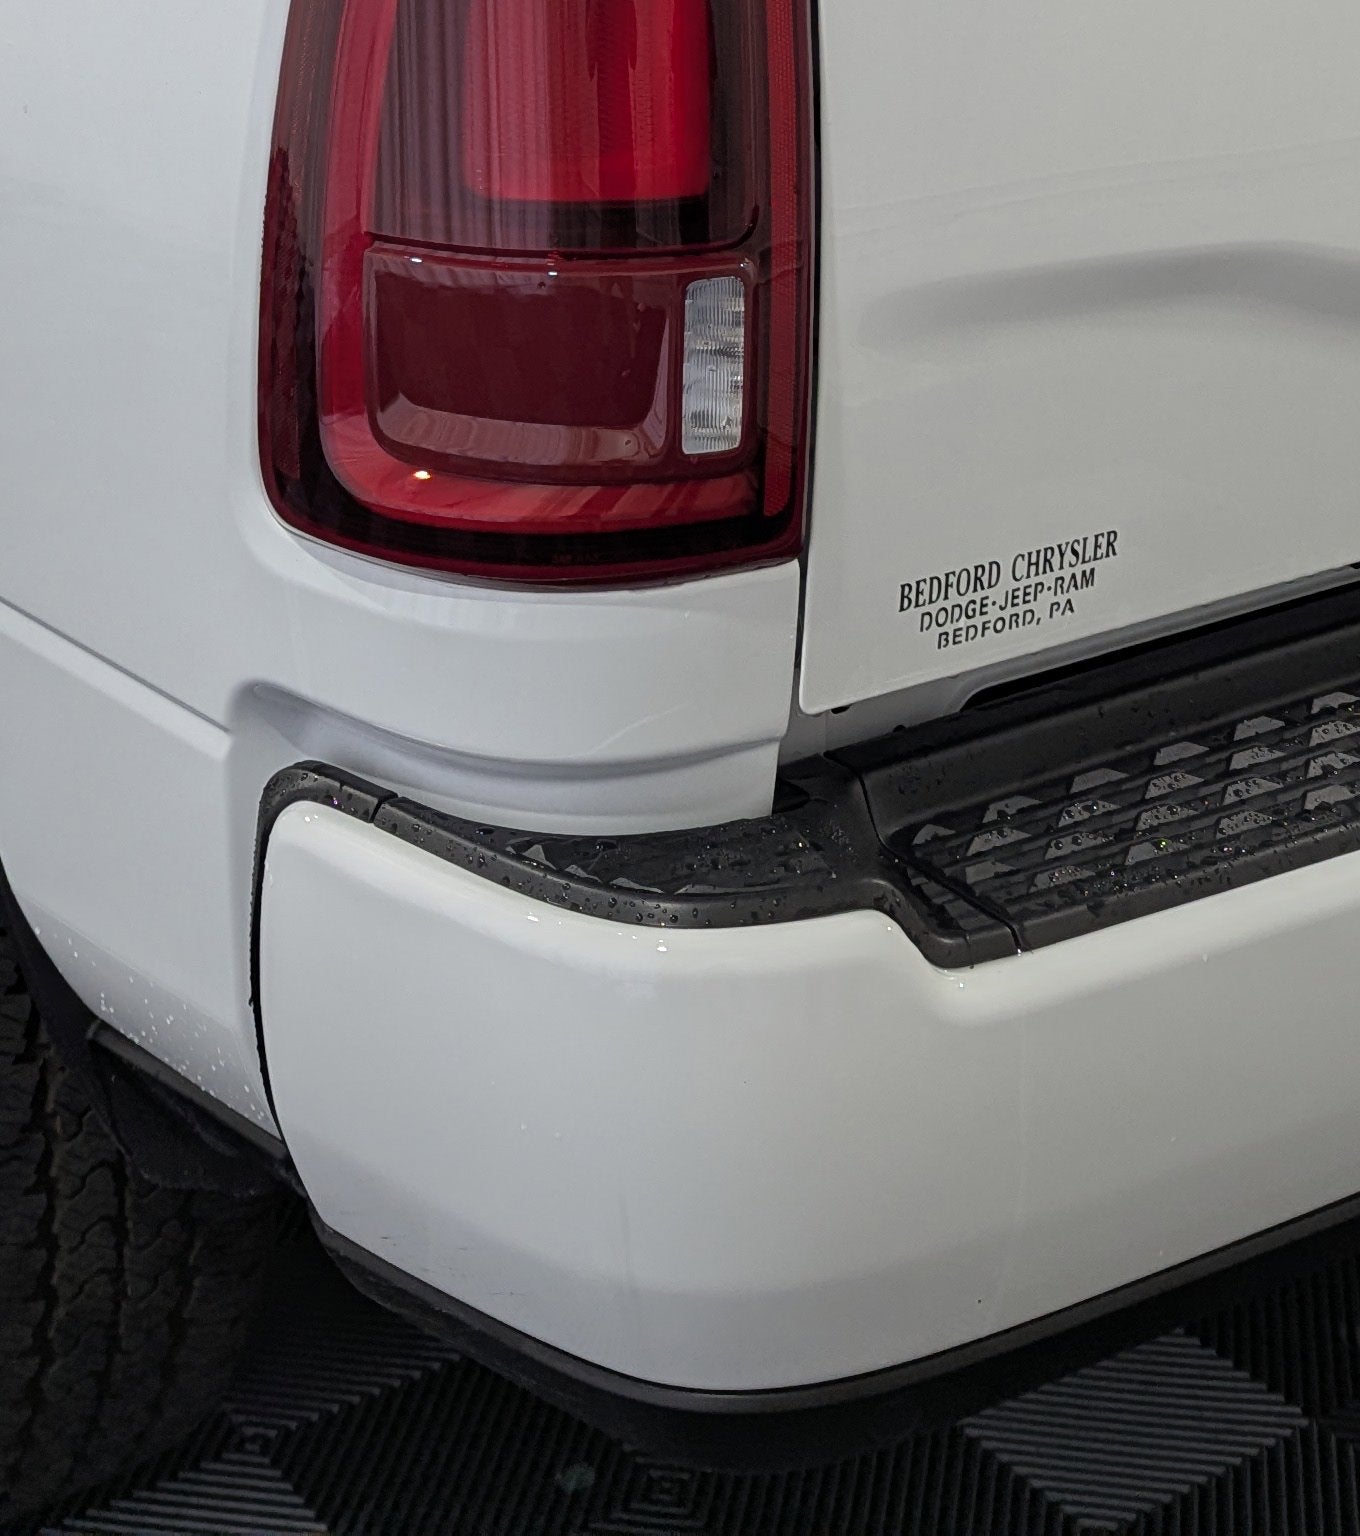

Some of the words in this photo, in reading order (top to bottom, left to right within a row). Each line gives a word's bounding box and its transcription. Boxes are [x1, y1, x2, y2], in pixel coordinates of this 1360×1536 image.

[898, 560, 1001, 612] BEDFORD
[1011, 530, 1118, 582] CHRYSLER
[937, 608, 1042, 650] BEDFORD,
[1049, 597, 1075, 619] PA
